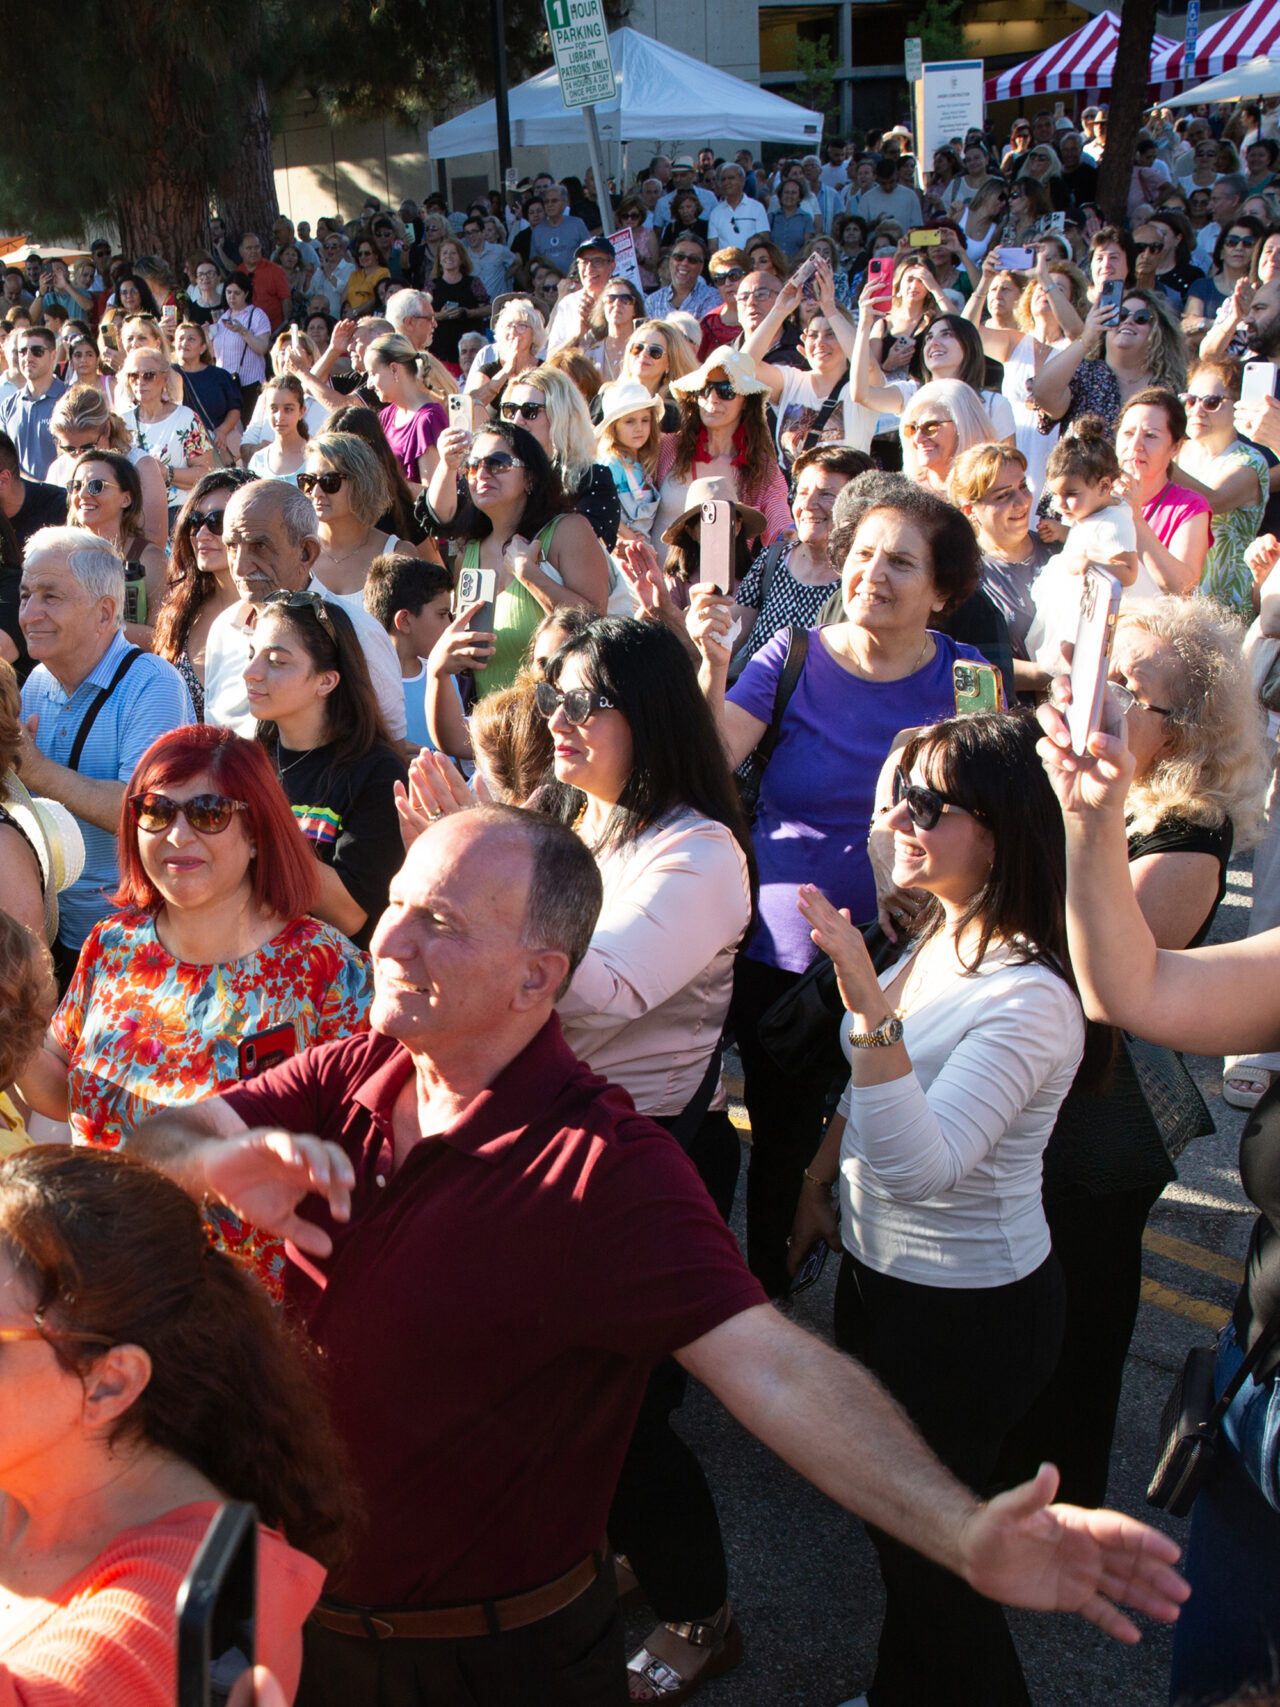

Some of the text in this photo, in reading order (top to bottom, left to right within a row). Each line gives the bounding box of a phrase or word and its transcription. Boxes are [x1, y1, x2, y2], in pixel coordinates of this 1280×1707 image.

[553, 0, 598, 26] 1 HOUR
[556, 22, 601, 45] PARKING
[575, 41, 588, 50] FOR
[568, 49, 596, 63] LIBRARY
[561, 58, 609, 78] PATRONS ONLY
[573, 76, 593, 88] HOURS
[598, 73, 609, 82] DAY
[569, 88, 584, 98] ONCE
[585, 85, 597, 94] PER
[598, 82, 609, 91] DAY
